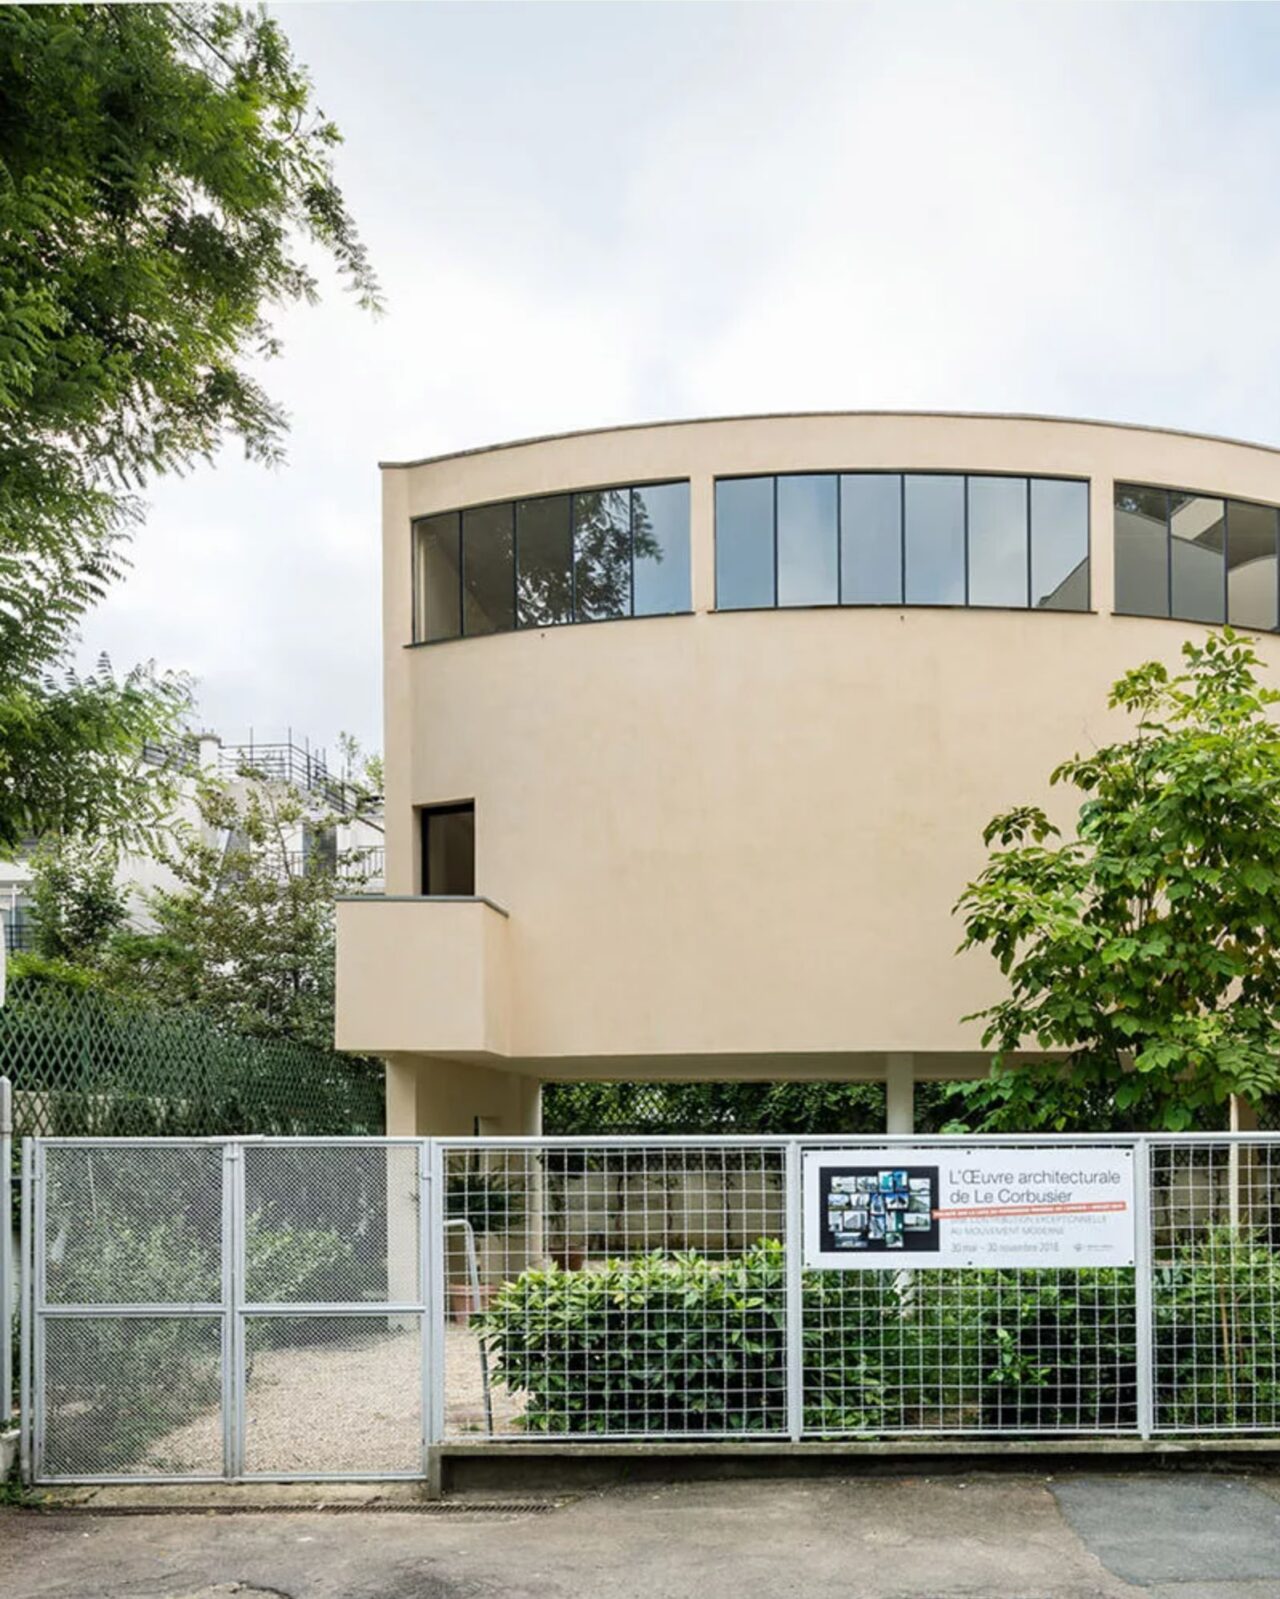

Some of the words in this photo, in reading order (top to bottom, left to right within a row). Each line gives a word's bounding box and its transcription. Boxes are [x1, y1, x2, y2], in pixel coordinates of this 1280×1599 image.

[949, 1169, 1014, 1185] L'Œuvre
[1018, 1169, 1121, 1185] architecturale
[949, 1189, 970, 1204] de
[974, 1189, 994, 1204] Le
[997, 1188, 1072, 1204] Corbusier
[964, 1227, 1019, 1236] MOUVEMENT
[1022, 1227, 1064, 1236] MODERNE
[1000, 1243, 1037, 1253] novembre
